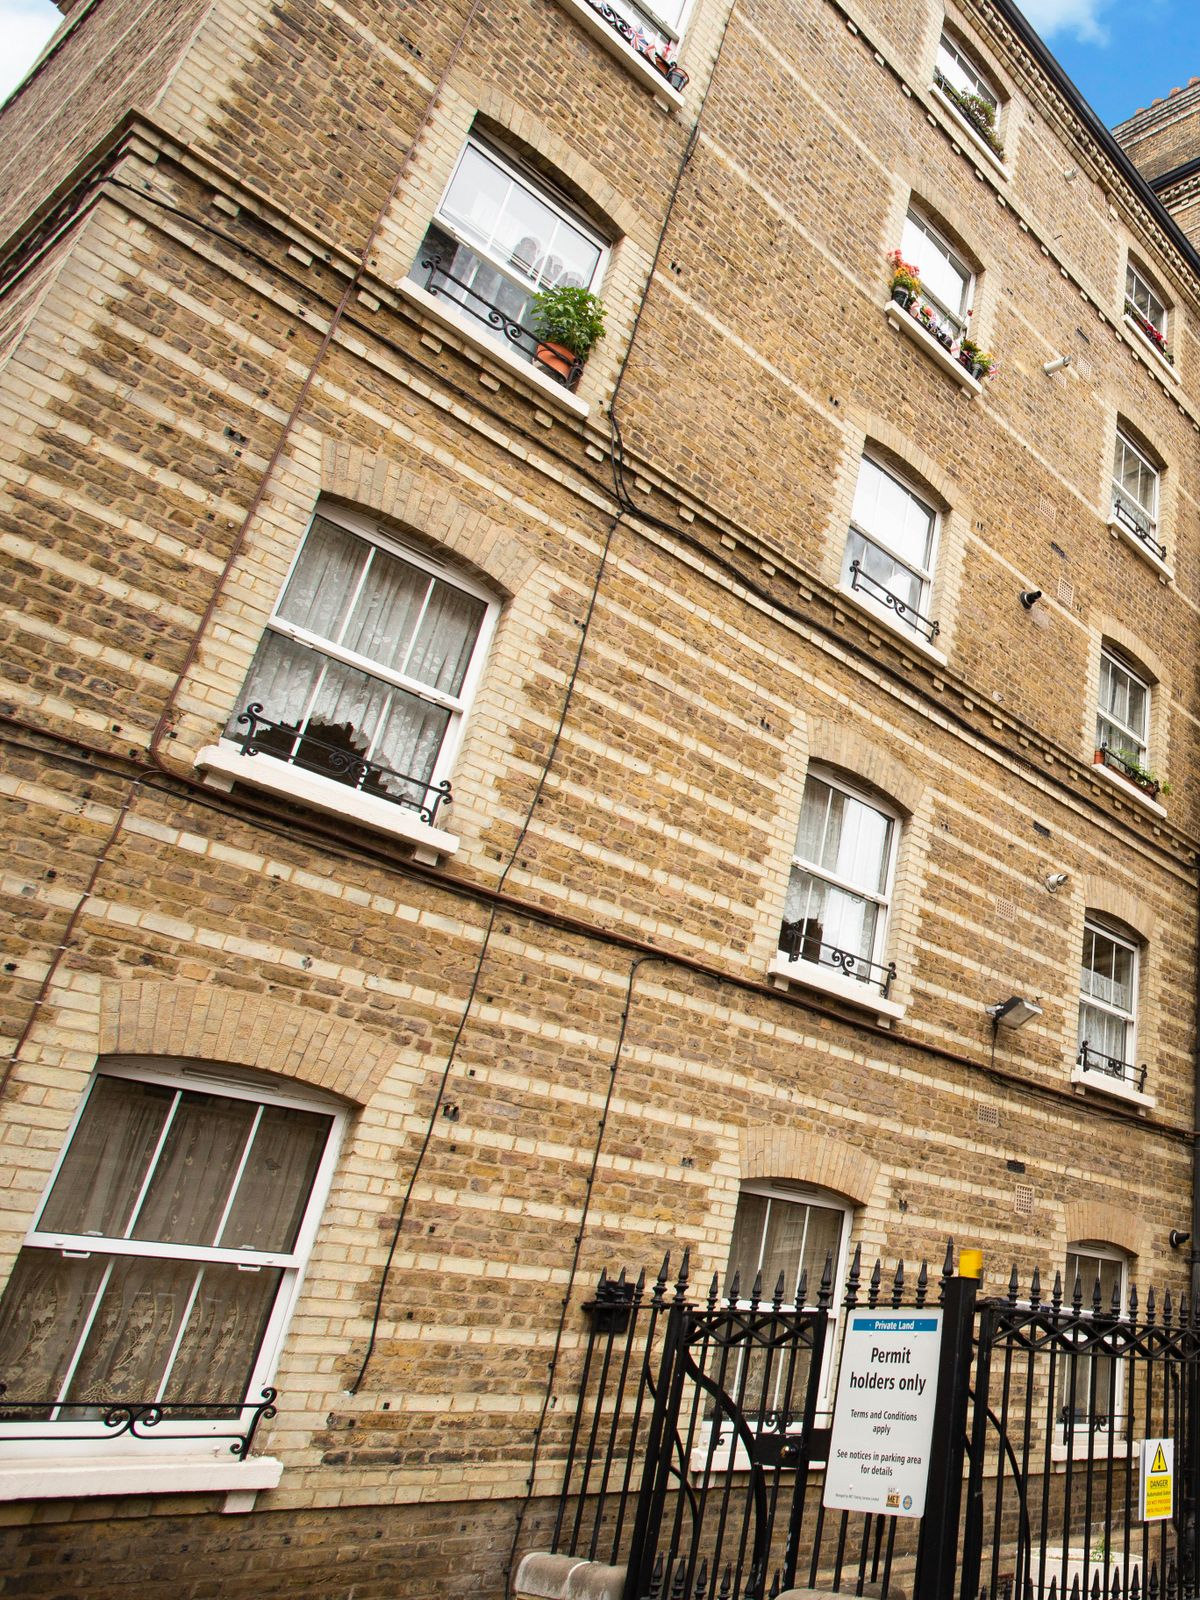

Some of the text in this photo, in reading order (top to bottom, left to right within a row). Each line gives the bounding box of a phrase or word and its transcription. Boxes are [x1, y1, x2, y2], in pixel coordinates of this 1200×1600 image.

[874, 1320, 915, 1330] Private Land
[870, 1347, 911, 1364] Permit
[849, 1371, 926, 1396] holders only
[850, 1409, 917, 1421] Terms and Conditions
[872, 1424, 891, 1435] apply
[836, 1449, 922, 1465] See notices in parking area
[860, 1464, 893, 1476] for details
[1150, 1479, 1168, 1488] DANGER
